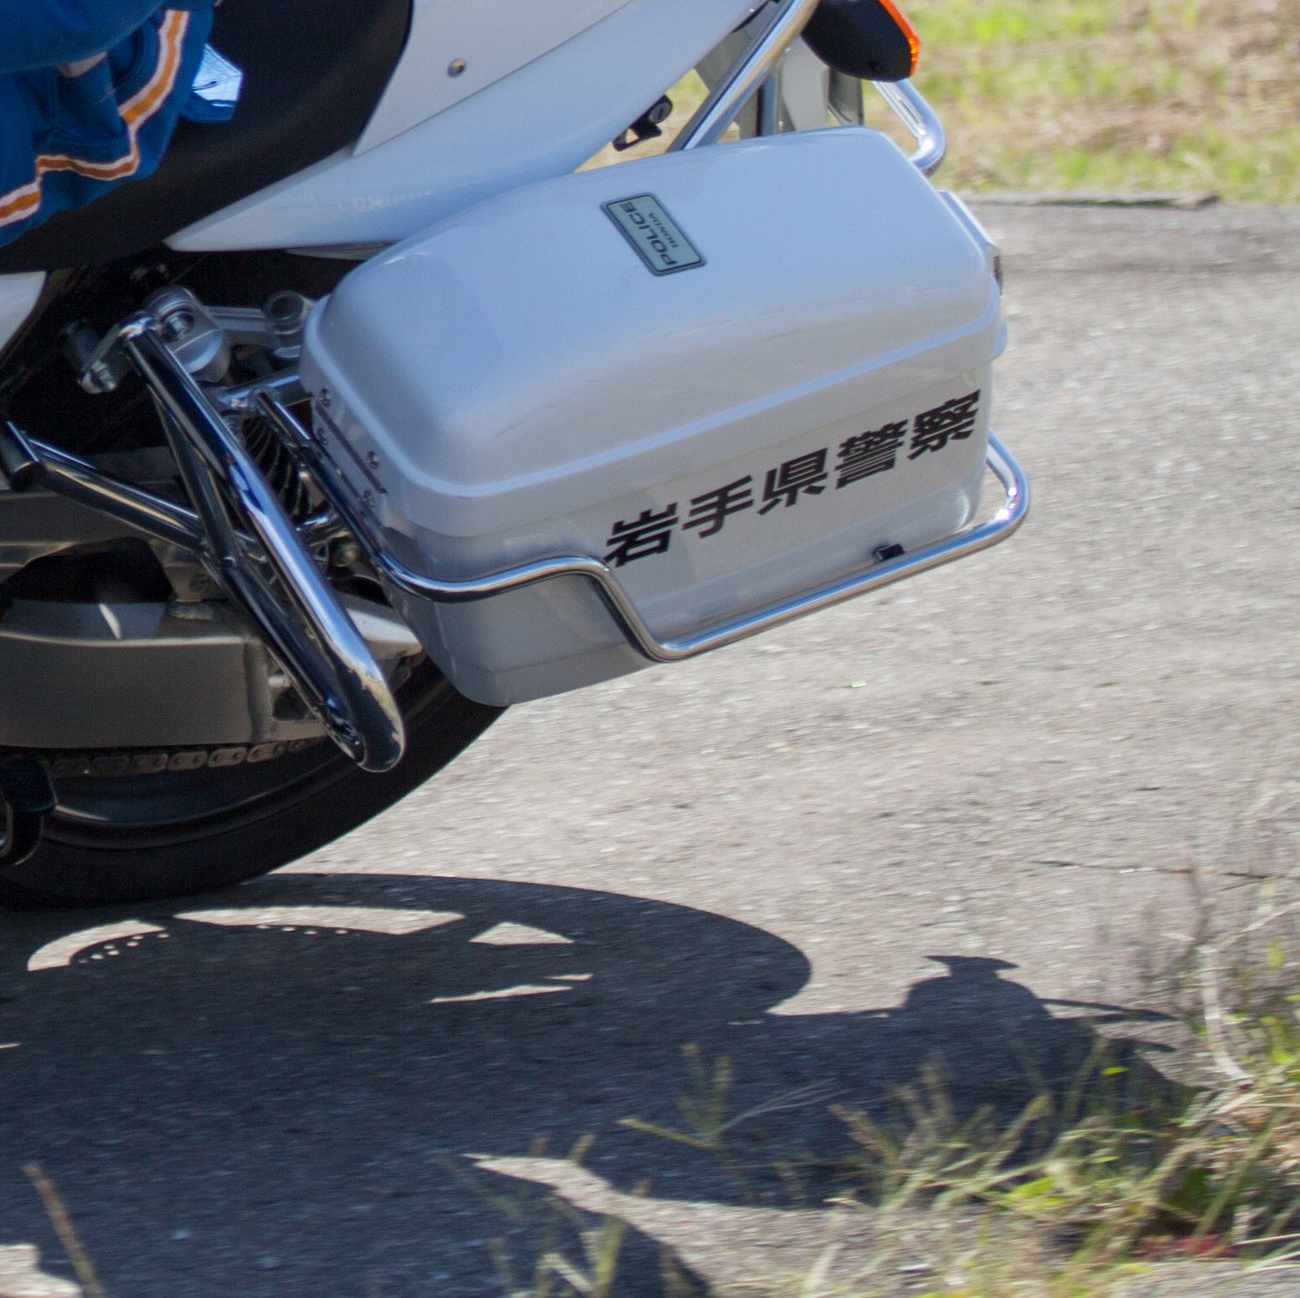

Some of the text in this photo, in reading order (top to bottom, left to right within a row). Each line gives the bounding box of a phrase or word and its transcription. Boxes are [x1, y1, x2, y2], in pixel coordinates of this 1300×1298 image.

[619, 201, 679, 266] POLICE
[603, 388, 983, 568] 岩手県警察
